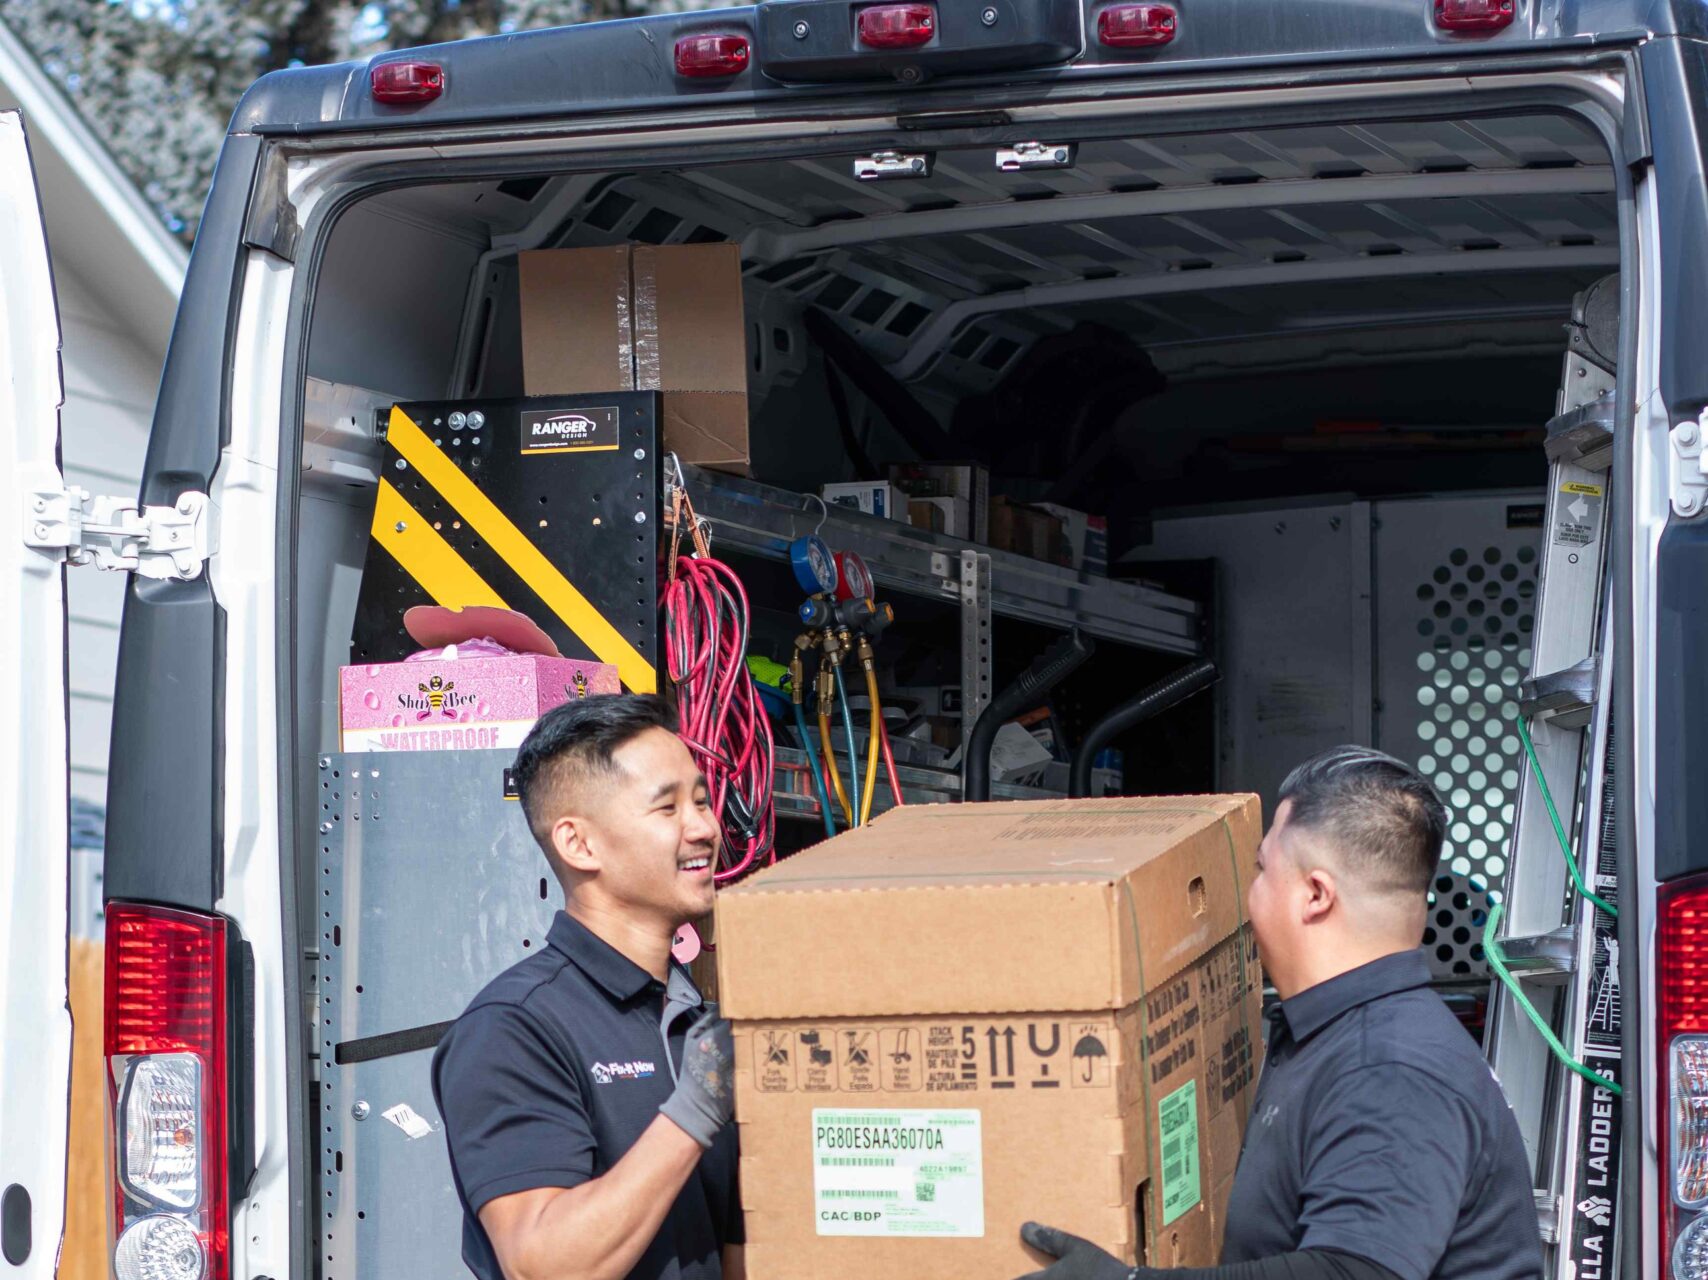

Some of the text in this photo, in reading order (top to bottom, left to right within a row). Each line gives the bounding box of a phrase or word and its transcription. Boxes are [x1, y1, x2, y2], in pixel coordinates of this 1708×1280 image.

[532, 421, 587, 434] RANGER
[397, 691, 476, 710] Shu Bee
[380, 727, 500, 750] WATERPROOF
[930, 1027, 952, 1036] STACK
[928, 1037, 954, 1046] HEIGHT
[962, 1026, 976, 1060] 5
[926, 1050, 959, 1059] HAUTEUR
[928, 1060, 956, 1069] DE PILE
[929, 1073, 955, 1081] ALTURA
[926, 1082, 978, 1091] DE APILAMIENTO
[1587, 1068, 1615, 1186] LADDERS
[817, 1127, 944, 1149] PG80ESAA36070A
